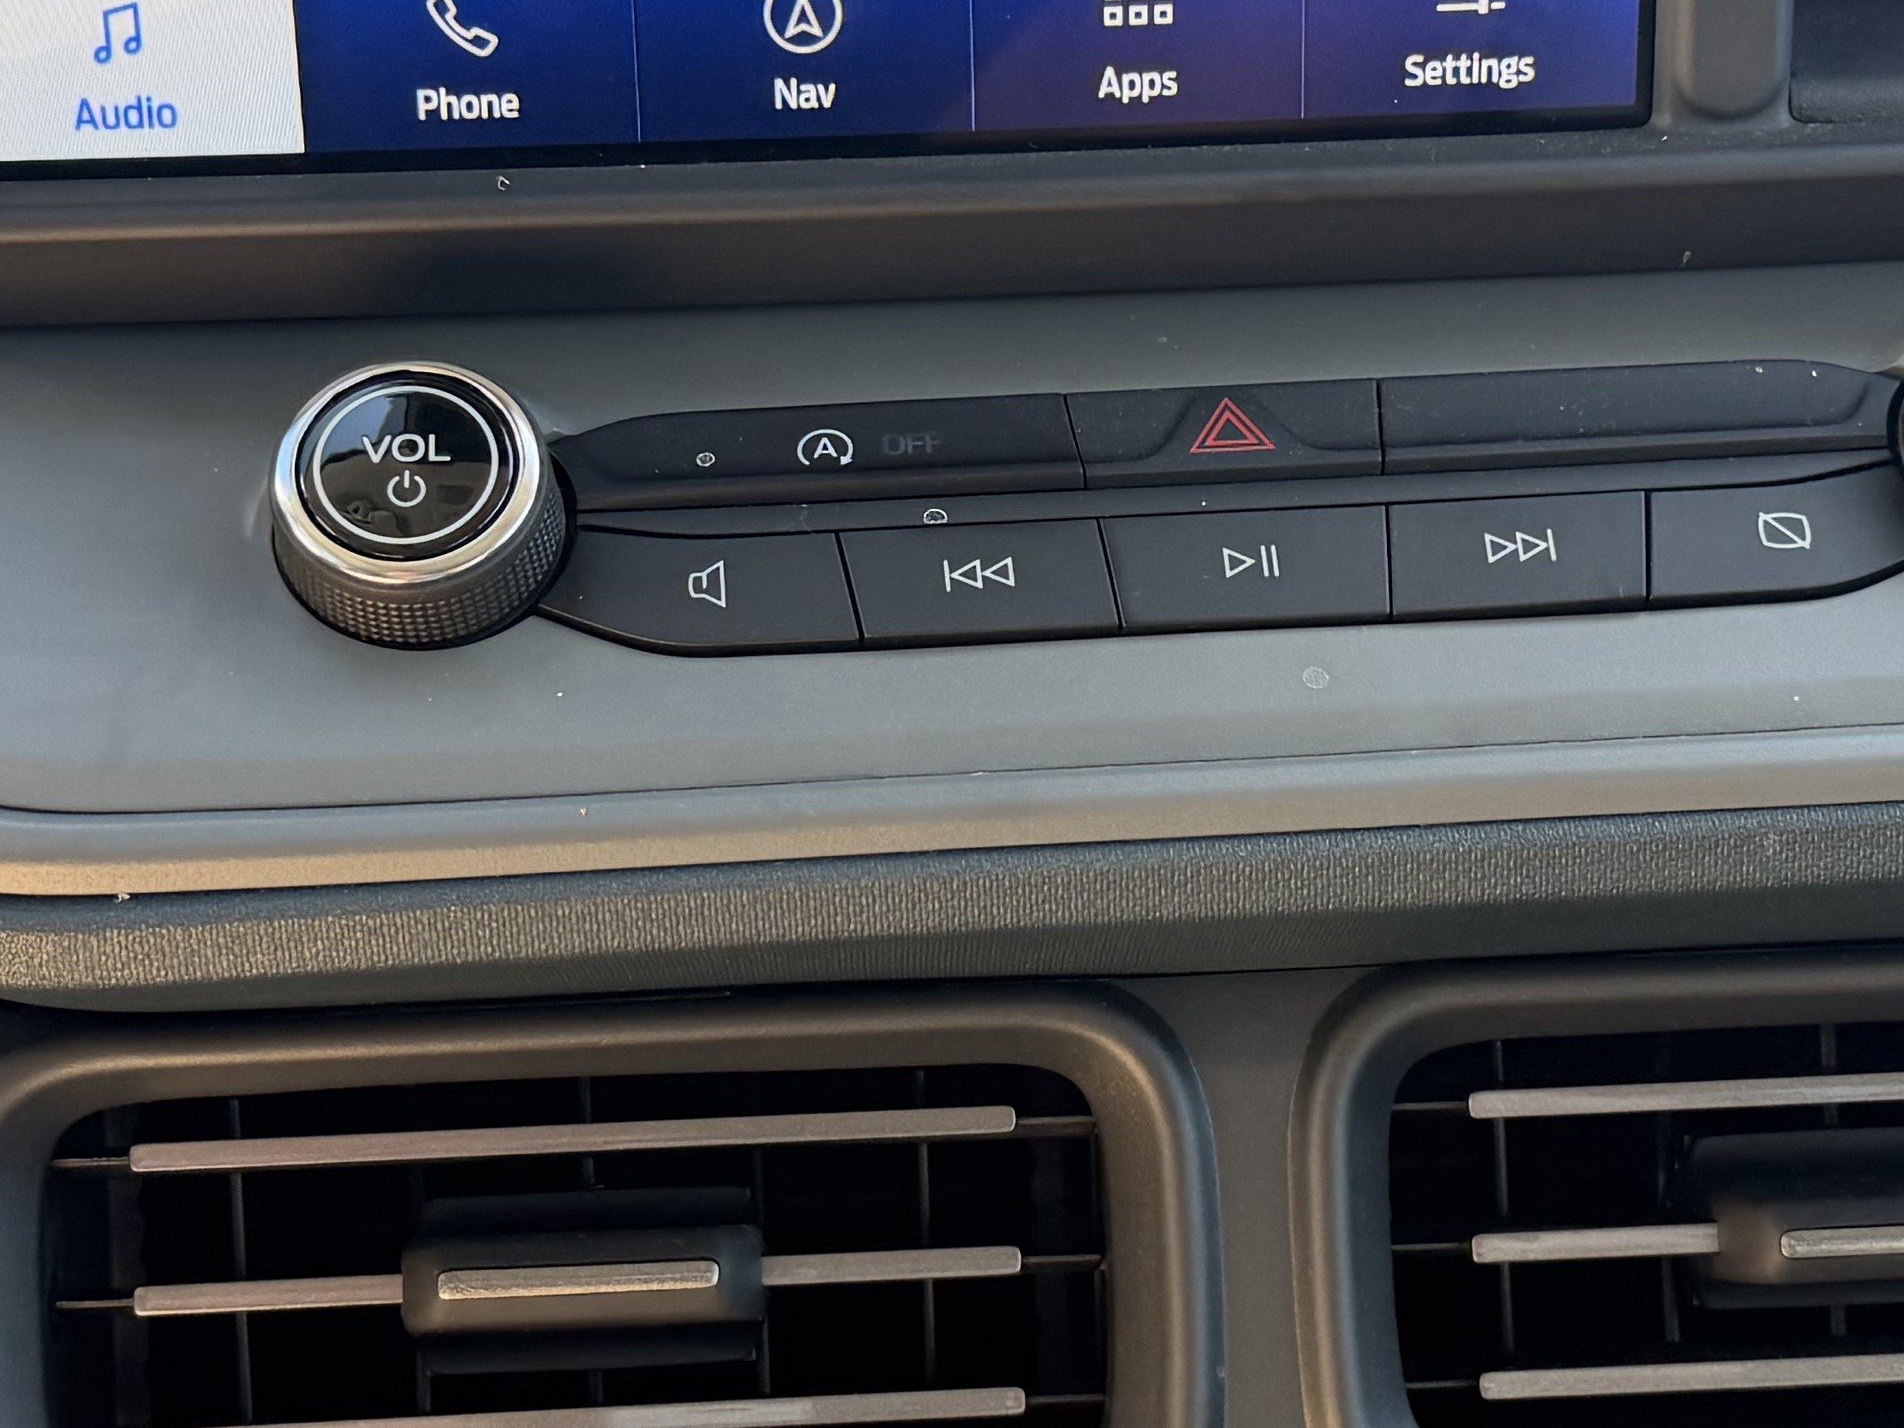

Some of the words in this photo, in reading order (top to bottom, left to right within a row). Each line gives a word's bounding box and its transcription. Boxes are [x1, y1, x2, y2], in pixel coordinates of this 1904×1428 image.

[1098, 65, 1178, 101] Apps
[1404, 52, 1536, 90] Settings
[417, 87, 519, 122] Phone
[773, 78, 836, 111] Nav
[74, 95, 178, 132] Audio
[362, 433, 451, 464] VOL
[881, 431, 943, 456] OFF
